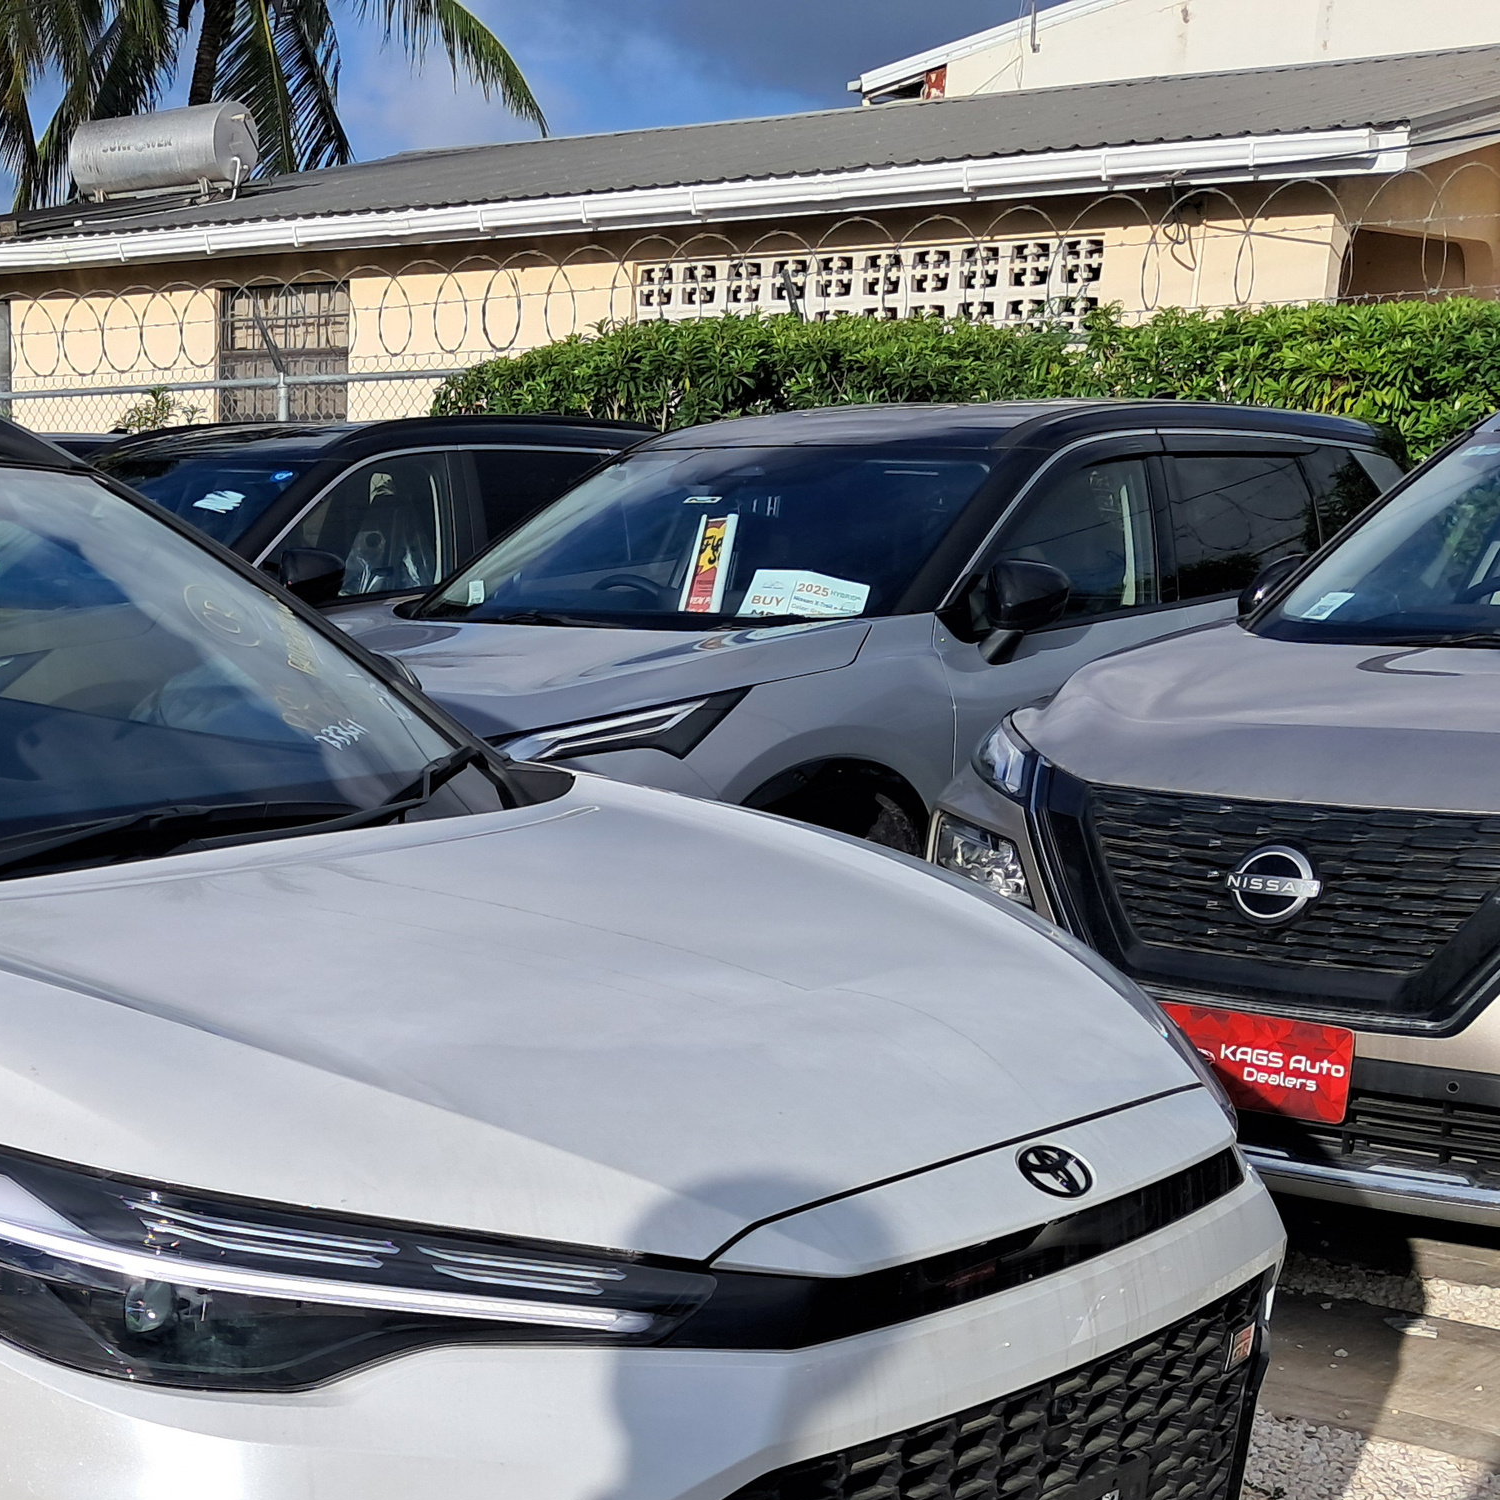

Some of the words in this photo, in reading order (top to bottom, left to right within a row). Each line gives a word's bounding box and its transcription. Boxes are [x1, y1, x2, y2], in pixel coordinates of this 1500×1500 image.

[796, 583, 830, 597] 2025
[751, 595, 785, 606] BUY
[1227, 874, 1318, 894] NISSAN
[1220, 1043, 1283, 1068] KAGS
[1289, 1055, 1345, 1078] Auto
[1243, 1067, 1317, 1092] Dealers
